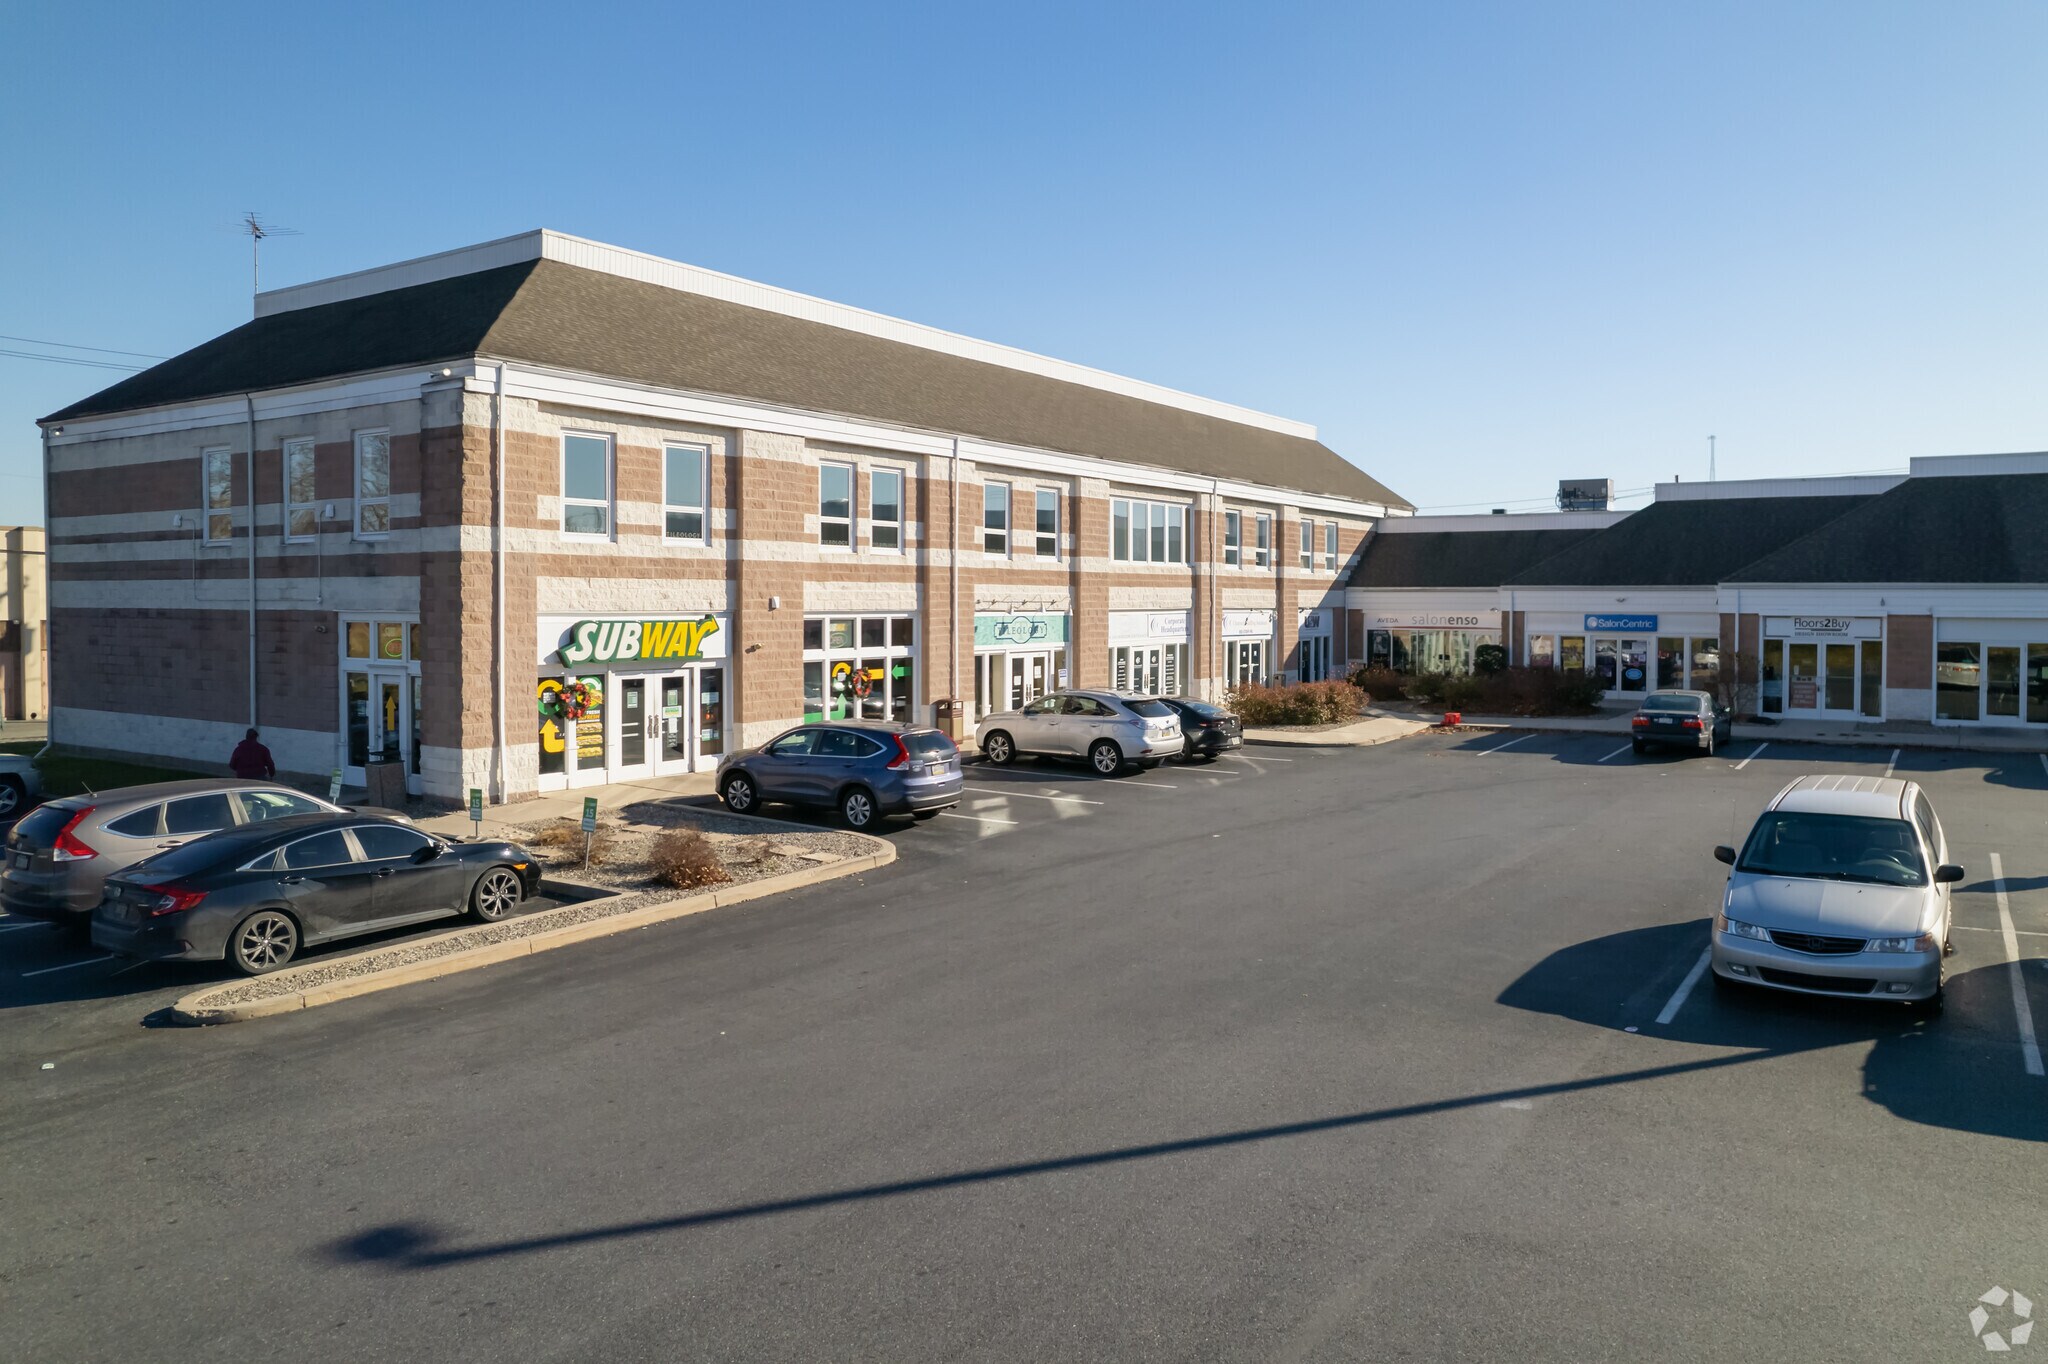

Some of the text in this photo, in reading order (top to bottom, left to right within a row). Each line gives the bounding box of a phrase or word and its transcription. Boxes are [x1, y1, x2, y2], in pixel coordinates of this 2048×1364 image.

[1411, 613, 1479, 626] salonenso
[1598, 619, 1653, 628] SalonCentric
[1794, 617, 1851, 630] Floors2Buy
[997, 626, 1045, 635] TLEOLOY
[565, 618, 720, 662] SUBWAY
[472, 799, 480, 808] 15
[586, 808, 594, 818] 15
